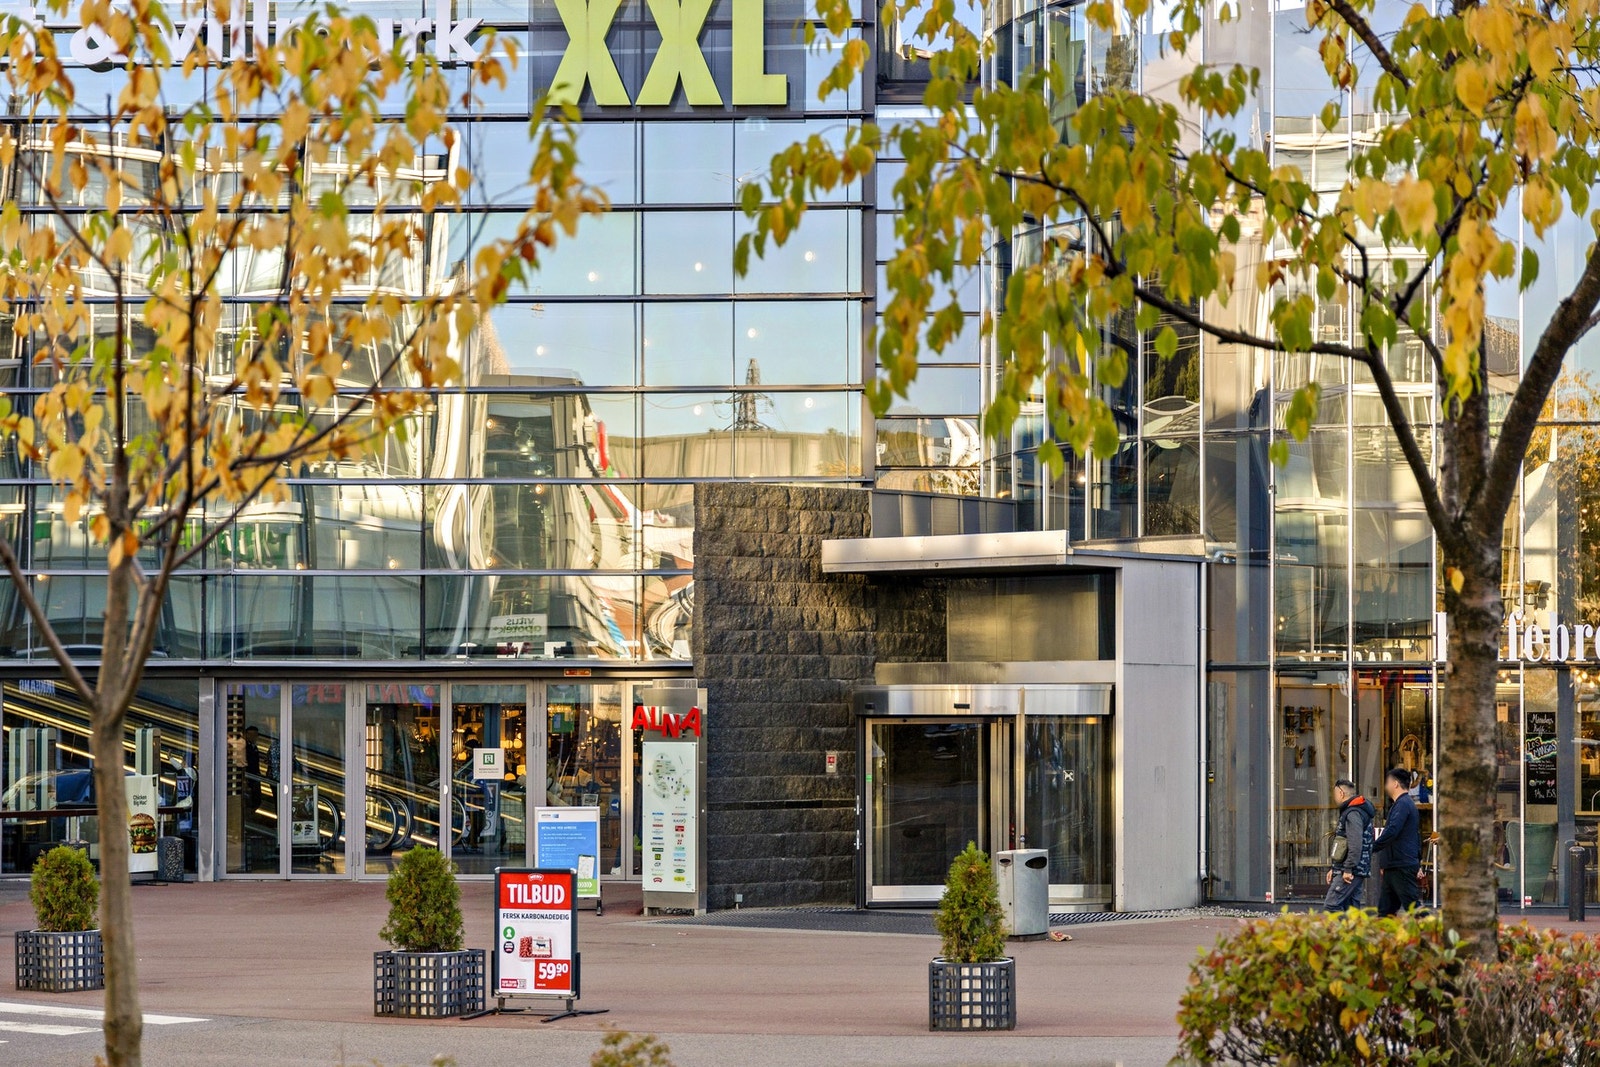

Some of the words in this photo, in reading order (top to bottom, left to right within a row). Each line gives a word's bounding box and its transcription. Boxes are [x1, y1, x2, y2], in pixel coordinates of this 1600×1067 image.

[546, 0, 788, 107] XXL
[1435, 611, 1600, 662] kfebr
[631, 705, 702, 738] ALNA
[507, 883, 565, 904] TILBUD
[502, 912, 521, 920] FERSK
[521, 912, 570, 920] KARBONADEDEIG
